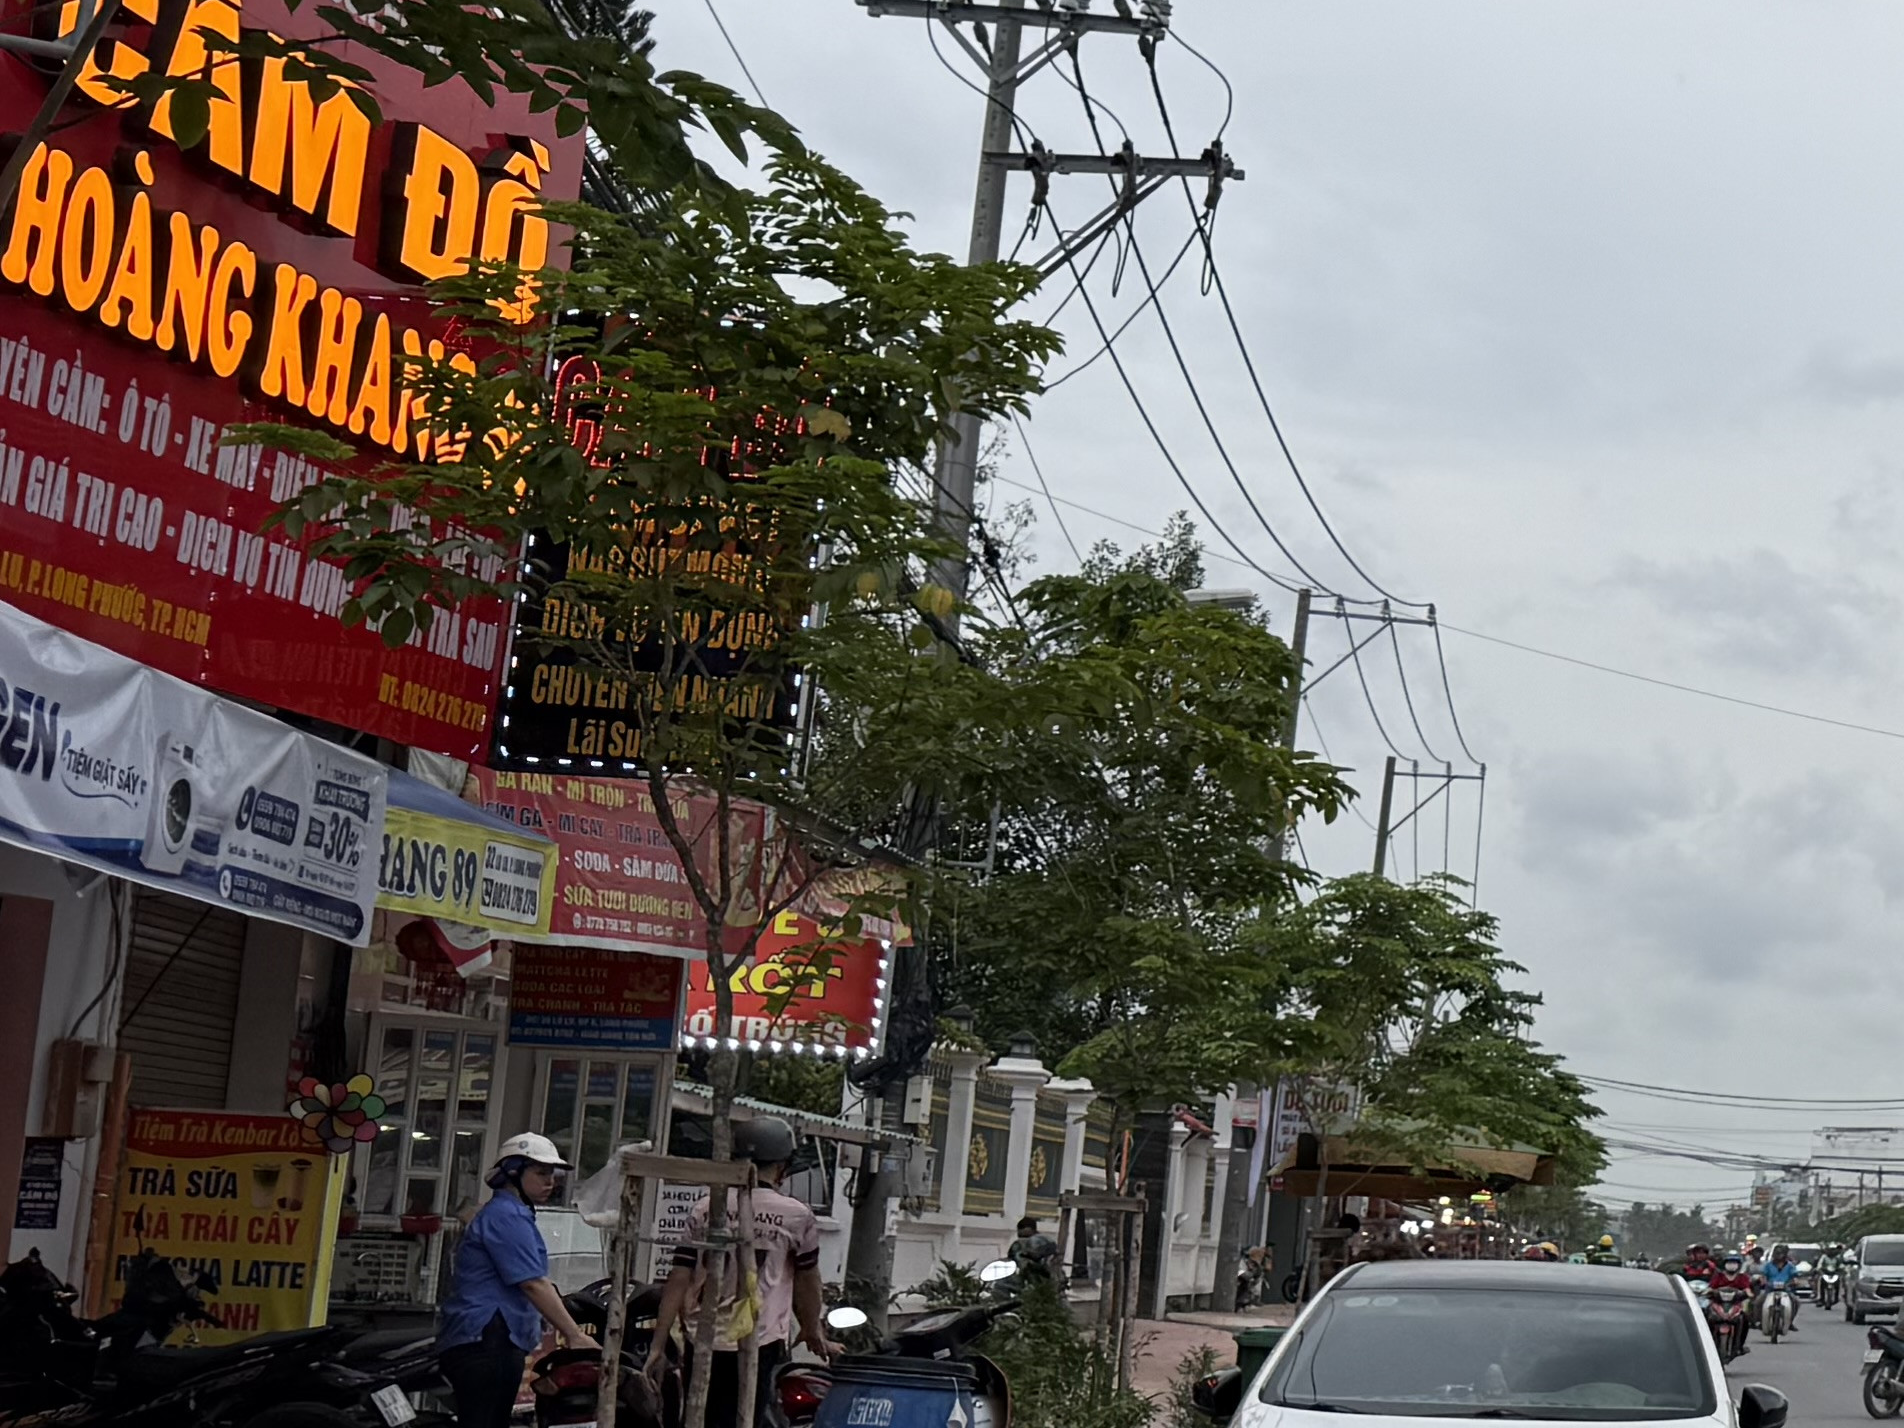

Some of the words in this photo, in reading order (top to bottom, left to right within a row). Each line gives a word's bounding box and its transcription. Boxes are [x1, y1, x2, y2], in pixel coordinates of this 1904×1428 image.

[1, 140, 257, 377] HOÀNG
[118, 377, 138, 443] Ô
[140, 391, 171, 457] TÔ
[183, 415, 215, 473] XE
[23, 451, 70, 524] GIÁ
[72, 472, 115, 546] TRỊ
[115, 486, 164, 553] CAO
[176, 509, 229, 576] DỊCH
[233, 529, 264, 595] VỤ
[463, 617, 498, 672] SAU
[42, 567, 88, 611] LONG
[324, 811, 360, 868] 30%
[574, 850, 612, 873] SODA
[452, 847, 478, 909] 89
[133, 1116, 176, 1145] Tiệm
[178, 1119, 208, 1143] Trà
[212, 1121, 276, 1147] Kenbar
[128, 1163, 176, 1197] TRÀ
[186, 1165, 238, 1199] SỮA
[180, 1209, 238, 1243] TRÁI
[247, 1211, 300, 1245] CÂY
[232, 1258, 305, 1290] LATTE
